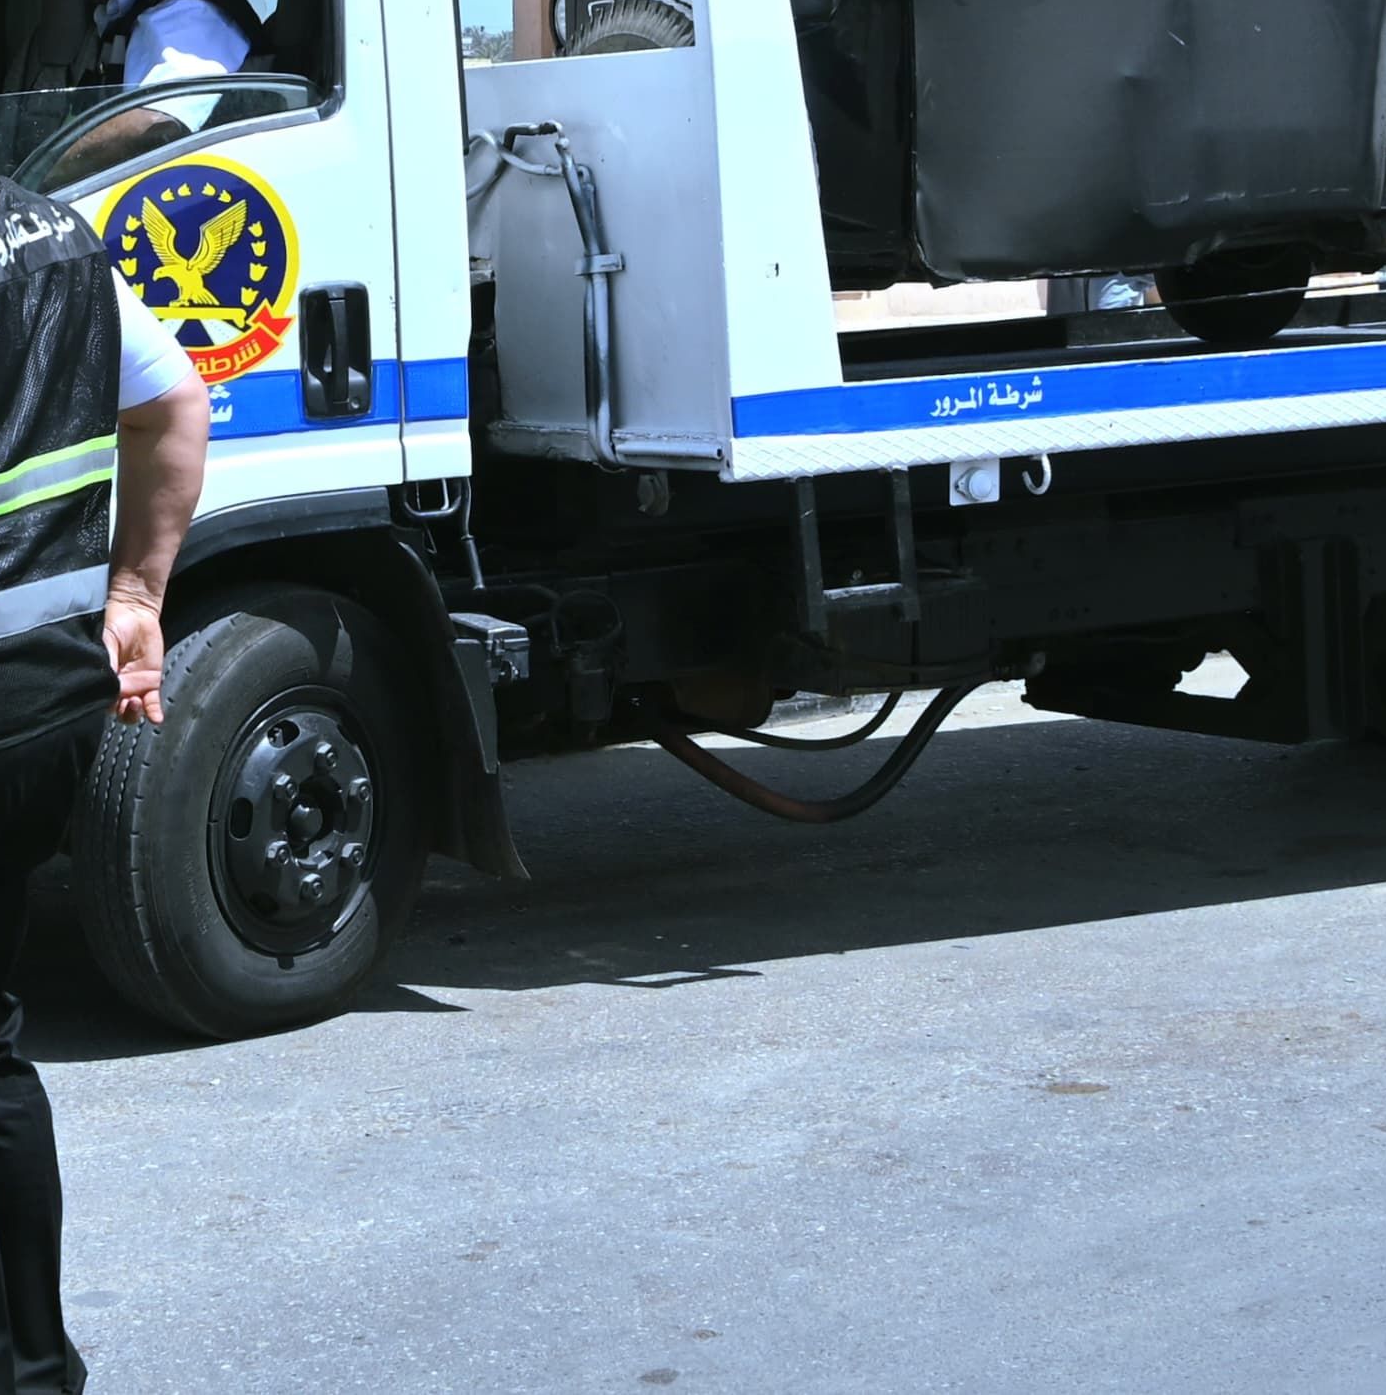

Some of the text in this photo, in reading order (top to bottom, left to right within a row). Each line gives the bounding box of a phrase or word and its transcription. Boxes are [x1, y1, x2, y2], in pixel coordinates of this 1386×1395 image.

[195, 339, 262, 373] شرطة
[929, 375, 1043, 417] شرطة المرور
